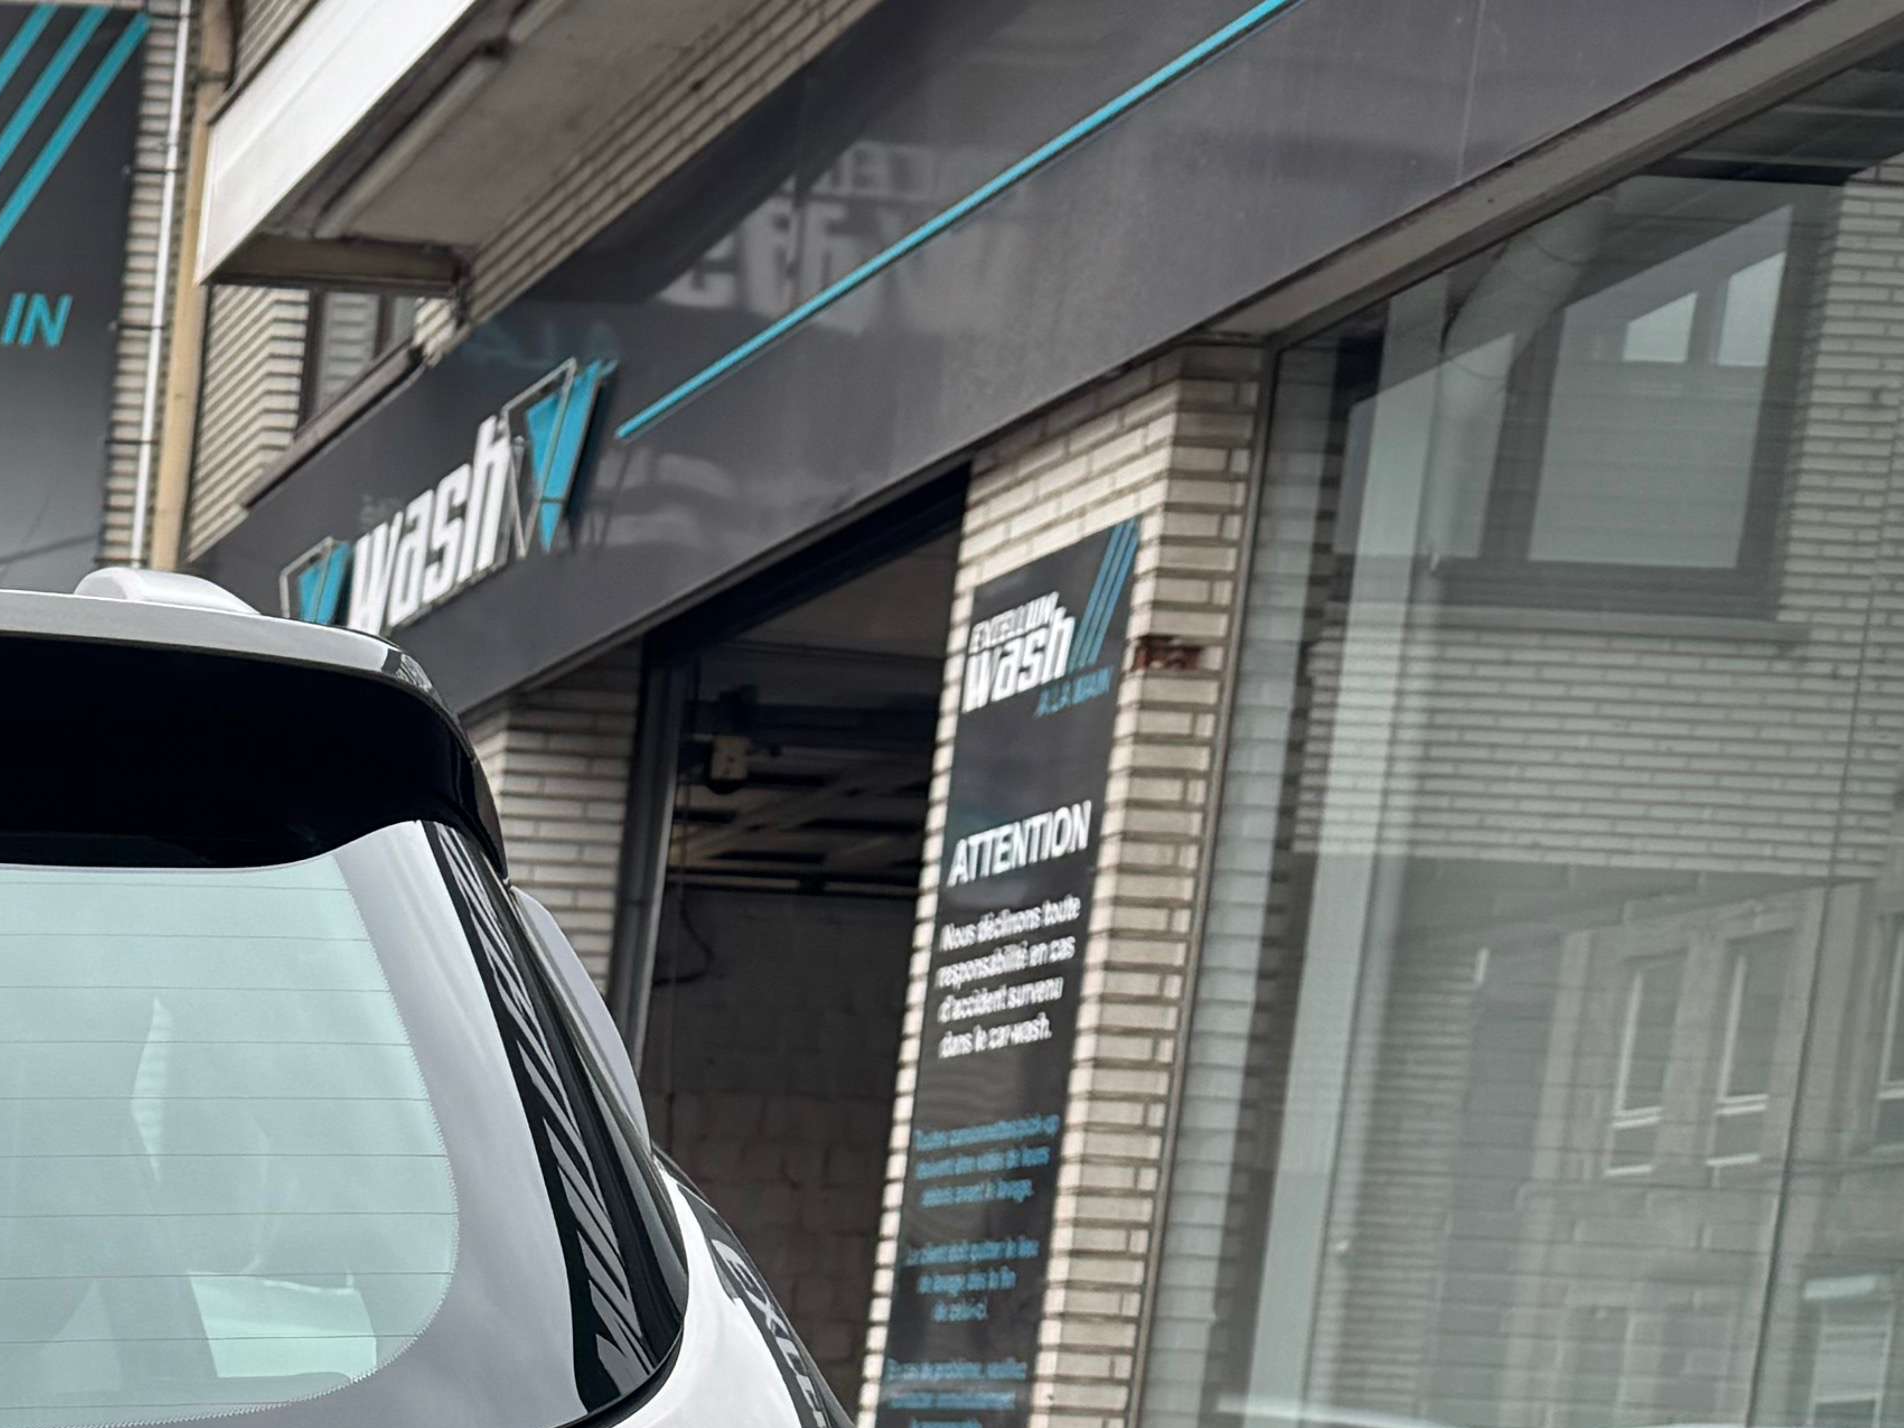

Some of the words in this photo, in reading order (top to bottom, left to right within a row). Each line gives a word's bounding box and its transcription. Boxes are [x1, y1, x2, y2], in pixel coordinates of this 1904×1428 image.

[346, 414, 512, 635] wash
[961, 605, 1077, 714] wash
[945, 799, 1092, 888] ATTENTION
[940, 922, 977, 951] Nous
